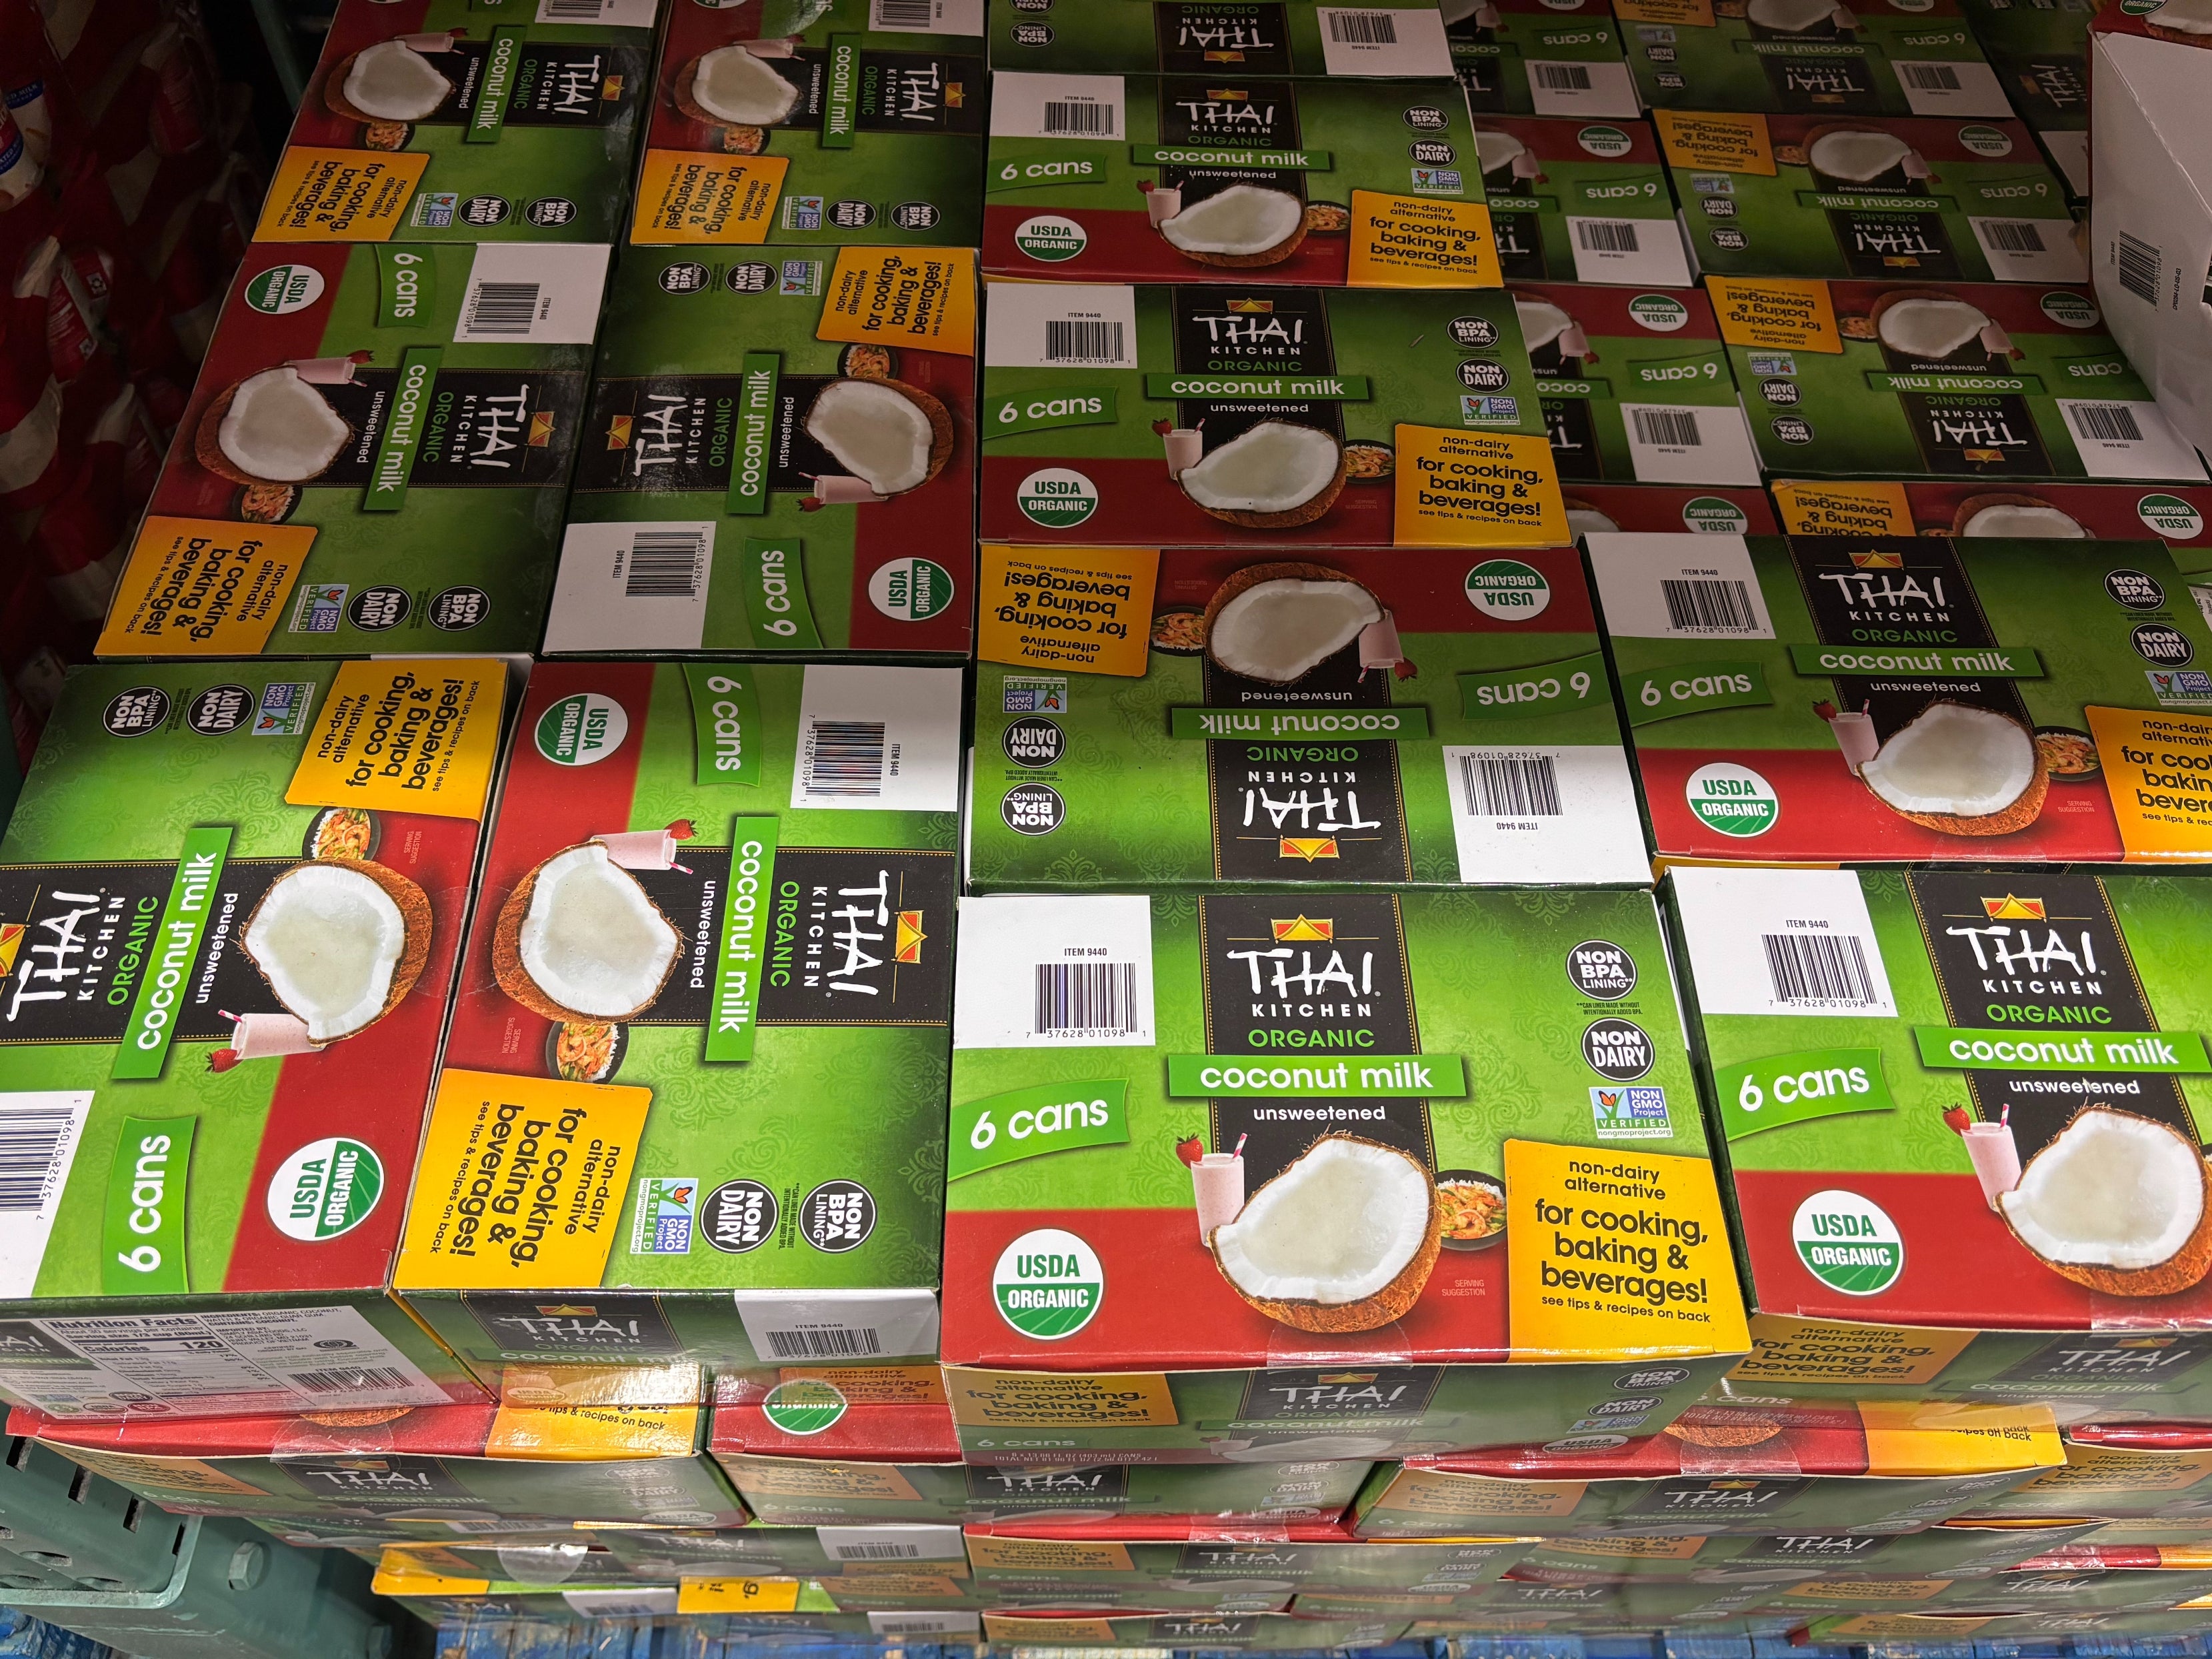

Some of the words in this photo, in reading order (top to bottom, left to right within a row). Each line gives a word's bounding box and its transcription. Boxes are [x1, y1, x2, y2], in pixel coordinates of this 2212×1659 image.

[1178, 25, 1274, 48] THAI
[1786, 73, 1864, 92] THAI
[1175, 101, 1275, 126] THAI
[1155, 150, 1254, 163] coconut
[1261, 153, 1309, 166] milk
[1000, 163, 1018, 180] 6
[1025, 161, 1093, 177] cans
[1585, 185, 1638, 198] cans
[1643, 182, 1657, 197] 6
[1815, 196, 1855, 207] milk
[1859, 197, 1938, 209] coconut
[393, 252, 423, 265] 6
[393, 269, 418, 317] cans
[1192, 315, 1303, 345] THAI
[1639, 365, 1697, 381] cans
[1703, 362, 1717, 379] 6
[747, 369, 771, 407] milk
[1171, 379, 1282, 395] coconut
[1291, 379, 1345, 395] milk
[1886, 376, 1931, 389] milk
[1936, 377, 2023, 389] coconut
[389, 365, 427, 445] coconut
[999, 401, 1019, 423] 6
[1027, 397, 1102, 419] cans
[469, 383, 529, 467] THAI
[739, 413, 767, 495] coconut
[375, 451, 403, 492] milk
[1416, 455, 1445, 471] for
[1450, 463, 1543, 485] cooking,
[1034, 481, 1081, 494] USDA
[1419, 490, 1541, 517] beverages!
[2153, 517, 2194, 530] USDA
[760, 550, 791, 612] cans
[887, 569, 907, 607] USDA
[1817, 573, 1945, 608] THAI
[2110, 576, 2151, 585] NON
[2116, 585, 2157, 595] BPA
[1482, 591, 1533, 606] USDA
[762, 618, 797, 635] 6
[1819, 651, 1943, 670] coconut
[1951, 652, 2015, 671] milk
[706, 676, 742, 693] 6
[1476, 676, 1561, 705] cans
[1569, 671, 1591, 699] 6
[555, 703, 580, 756] ORGANIC
[581, 708, 609, 750] USDA
[1198, 713, 1261, 734] milk
[1270, 713, 1399, 734] coconut
[710, 700, 741, 771] cans
[1009, 728, 1056, 744] DAIRY
[1011, 744, 1054, 756] NON
[1702, 779, 1758, 796] USDA
[1242, 786, 1381, 831] THAI
[1701, 803, 1769, 817] ORGANIC
[727, 841, 763, 961] coconut
[769, 881, 799, 987] ORGANIC
[826, 869, 889, 996] THAI
[6, 891, 100, 1022] THAI
[107, 896, 159, 1005] ORGANIC
[137, 920, 197, 1050] coconut
[180, 852, 218, 910] milk
[1064, 948, 1085, 956] ITEM
[1087, 948, 1107, 956] 9440
[1575, 951, 1622, 964] NON
[1946, 926, 2096, 976] THAI
[1226, 948, 1373, 999] THAI
[1580, 964, 1627, 978] BPA
[717, 971, 749, 1034] milk
[1251, 1004, 1371, 1018] KITCHEN
[1248, 1029, 1375, 1048] ORGANIC
[1591, 1031, 1641, 1046] NON
[1592, 1046, 1645, 1067] DAIRY
[1949, 1039, 2095, 1064] coconut
[2104, 1038, 2179, 1064] milk
[1200, 1062, 1349, 1089] coconut
[1360, 1062, 1433, 1088] milk
[1630, 1090, 1660, 1100] NON
[1739, 1074, 1763, 1112] 6
[1773, 1067, 1870, 1104] cans
[2009, 1079, 2141, 1094] unsweetened
[1253, 1106, 1386, 1121] unsweetened
[1631, 1099, 1663, 1110] GMO
[1633, 1108, 1664, 1118] Project
[553, 1108, 587, 1144] for
[970, 1110, 997, 1150] 6
[1008, 1099, 1109, 1140] cans
[1597, 1129, 1671, 1138] nongmoproject.org
[1600, 1118, 1669, 1129] VERIFIED
[1569, 1161, 1660, 1185] non-dairy
[130, 1134, 171, 1233] cans
[289, 1158, 326, 1218] USDA
[325, 1150, 359, 1225] ORGANIC
[1564, 1177, 1666, 1200] alternative
[509, 1149, 567, 1268] cooking,
[715, 1190, 745, 1244] DAIRY
[741, 1191, 763, 1242] NON
[1535, 1198, 1574, 1226] for
[1581, 1209, 1708, 1247] cooking,
[118, 1245, 162, 1272] 6
[1555, 1231, 1657, 1274] baking
[1667, 1244, 1689, 1270] &
[1017, 1254, 1081, 1278] USDA
[1441, 1288, 1486, 1296] SUGGESTION
[1455, 1279, 1485, 1288] SERVING
[1541, 1260, 1707, 1306] beverages!
[1007, 1288, 1089, 1309] ORGANIC
[1541, 1296, 1564, 1306] see
[1567, 1297, 1590, 1310] tips
[1594, 1300, 1603, 1311] &
[1607, 1304, 1654, 1317] recipes
[1657, 1310, 1673, 1319] on
[1677, 1309, 1711, 1323] back
[48, 1319, 137, 1330] Nutrition
[143, 1316, 199, 1327] Facts
[500, 1317, 640, 1337] THAI
[179, 1340, 225, 1350] 120
[1799, 1343, 1937, 1357] cooking,
[499, 1352, 627, 1364] coconut
[1740, 1360, 1916, 1375] beverages!
[1761, 1350, 1874, 1366] baking
[1879, 1355, 1905, 1364] &
[2058, 1348, 2191, 1367] THAI
[966, 1390, 1007, 1400] for
[1014, 1392, 1148, 1402] cooking,
[1268, 1385, 1407, 1404] THAI
[1970, 1382, 2099, 1392] coconut
[2105, 1382, 2165, 1392] milk
[982, 1408, 1149, 1420] beverages!
[990, 1400, 1098, 1412] baking
[1107, 1401, 1129, 1409] &
[580, 1408, 620, 1424] recipes
[622, 1416, 635, 1426] on
[638, 1418, 666, 1431] back
[977, 1439, 995, 1448] 6
[1003, 1439, 1076, 1447] cans
[306, 1470, 431, 1486] THAI
[1664, 1490, 1779, 1504] THAI
